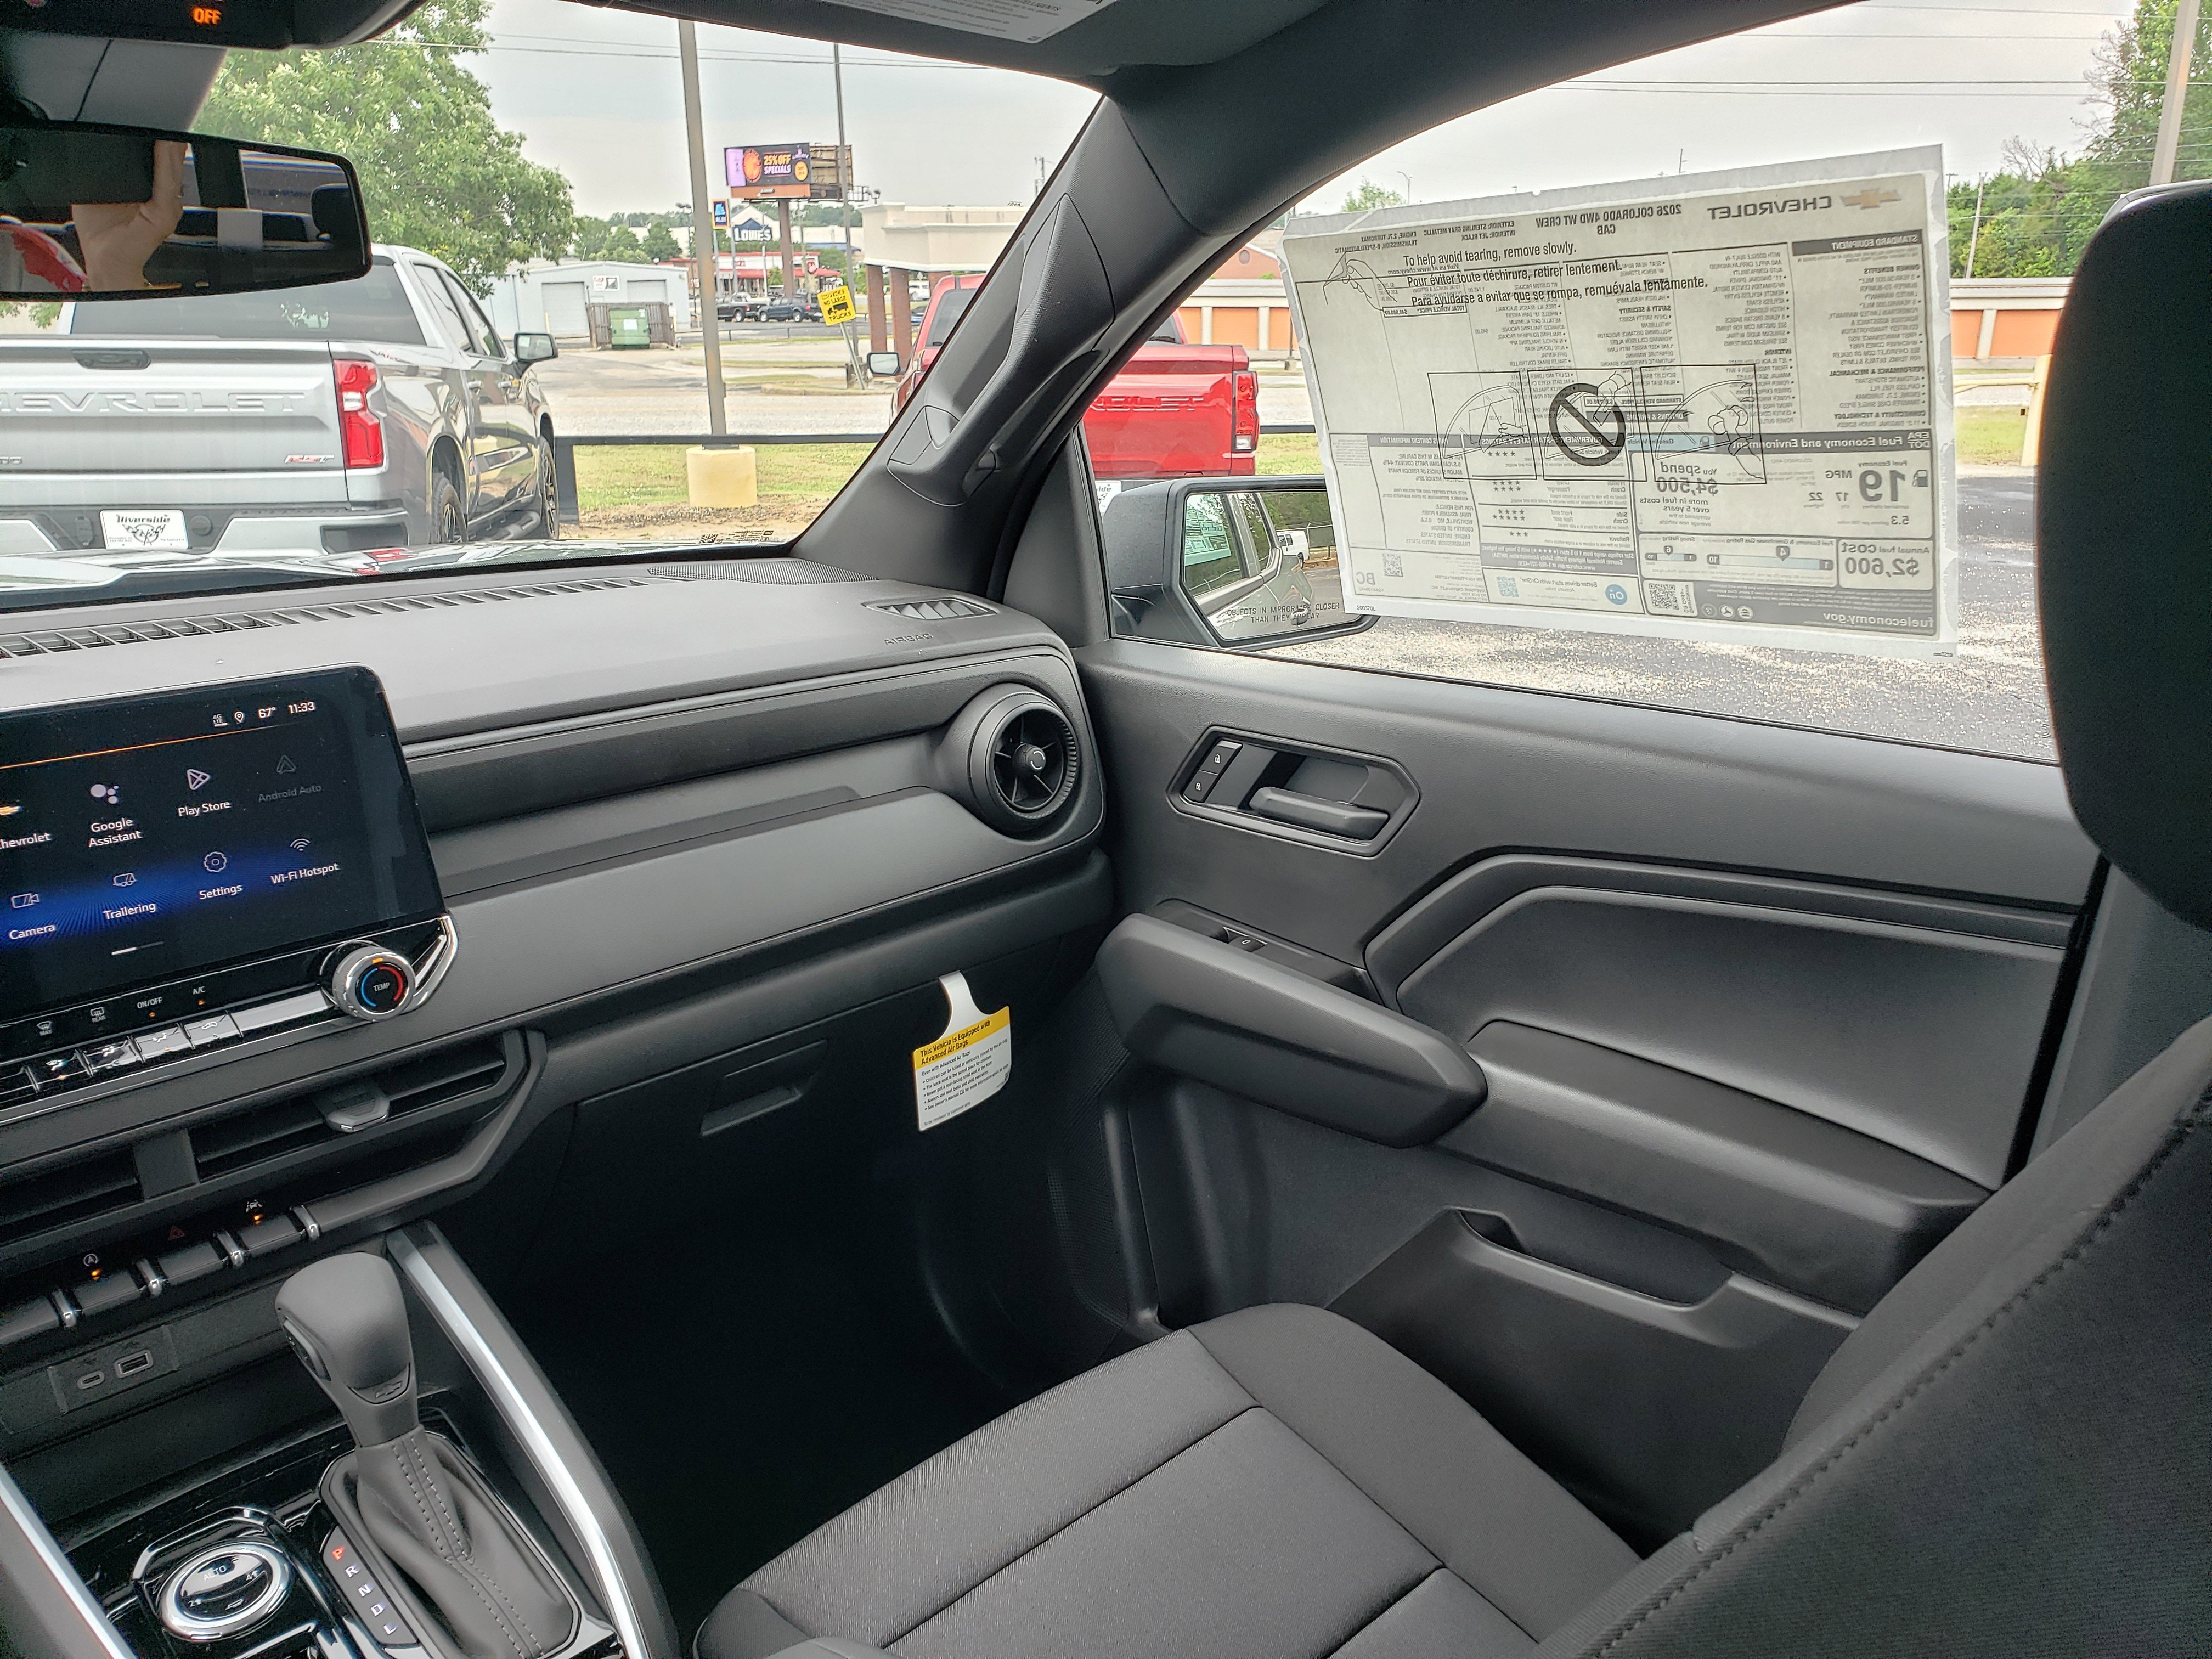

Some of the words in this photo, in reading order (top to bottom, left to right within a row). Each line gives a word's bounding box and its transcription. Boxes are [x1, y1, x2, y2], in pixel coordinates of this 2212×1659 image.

[194, 7, 222, 25] OFF
[778, 154, 791, 165] OFF
[764, 165, 791, 175] SPECIALS
[1403, 255, 1414, 266] To
[1418, 253, 1436, 268] help
[1438, 251, 1463, 263] avoid
[1465, 249, 1501, 264] tearing,
[1504, 247, 1541, 259] remove
[1543, 243, 1577, 258] slowly.
[1407, 274, 1427, 286] Pour
[1430, 272, 1455, 285] éviter
[1456, 270, 1480, 283] toute
[1482, 267, 1530, 283] déchirure,
[1534, 265, 1562, 278] retirer
[1565, 261, 1622, 275] lentement.
[1412, 294, 1432, 306] Para
[1434, 291, 1474, 307] ayudarse
[1477, 293, 1482, 302] a
[1486, 289, 1511, 301] evitar
[1514, 290, 1531, 302] que
[1533, 289, 1544, 298] se
[1547, 286, 1582, 300] rompa,
[1585, 281, 1641, 295] remuévala
[1644, 276, 1708, 291] lentamente.
[831, 294, 847, 303] LARGE
[829, 311, 851, 321] TRUCKS
[284, 454, 335, 464] RST
[116, 514, 171, 523] Riverside
[884, 634, 933, 645] AIRBAG
[288, 702, 314, 714] 11:33
[258, 787, 297, 803] Android
[300, 784, 321, 794] Auto
[177, 804, 200, 818] Play
[202, 800, 232, 811] Store
[91, 818, 134, 834] Google
[88, 831, 143, 848] Assistant
[270, 872, 298, 884] Wi-Fi
[300, 863, 340, 879] Hotspot
[199, 885, 244, 900] Settings
[103, 904, 157, 920] Trailering
[9, 924, 57, 940] Camera
[193, 986, 206, 995] A/C
[374, 981, 390, 991] TEMP
[137, 997, 163, 1009] ON/OFF
[92, 1014, 106, 1023] REAR
[921, 1046, 931, 1057] This
[933, 1038, 951, 1052] Vehicle
[958, 1025, 979, 1041] Equipped
[981, 1020, 991, 1030] with
[922, 1050, 946, 1065] Advanced
[956, 1040, 968, 1052] Bags
[332, 1547, 344, 1560] P
[203, 1565, 227, 1581] AUTO
[345, 1566, 359, 1578] R
[358, 1583, 372, 1597] N
[370, 1604, 384, 1616] D
[383, 1623, 396, 1635] L
